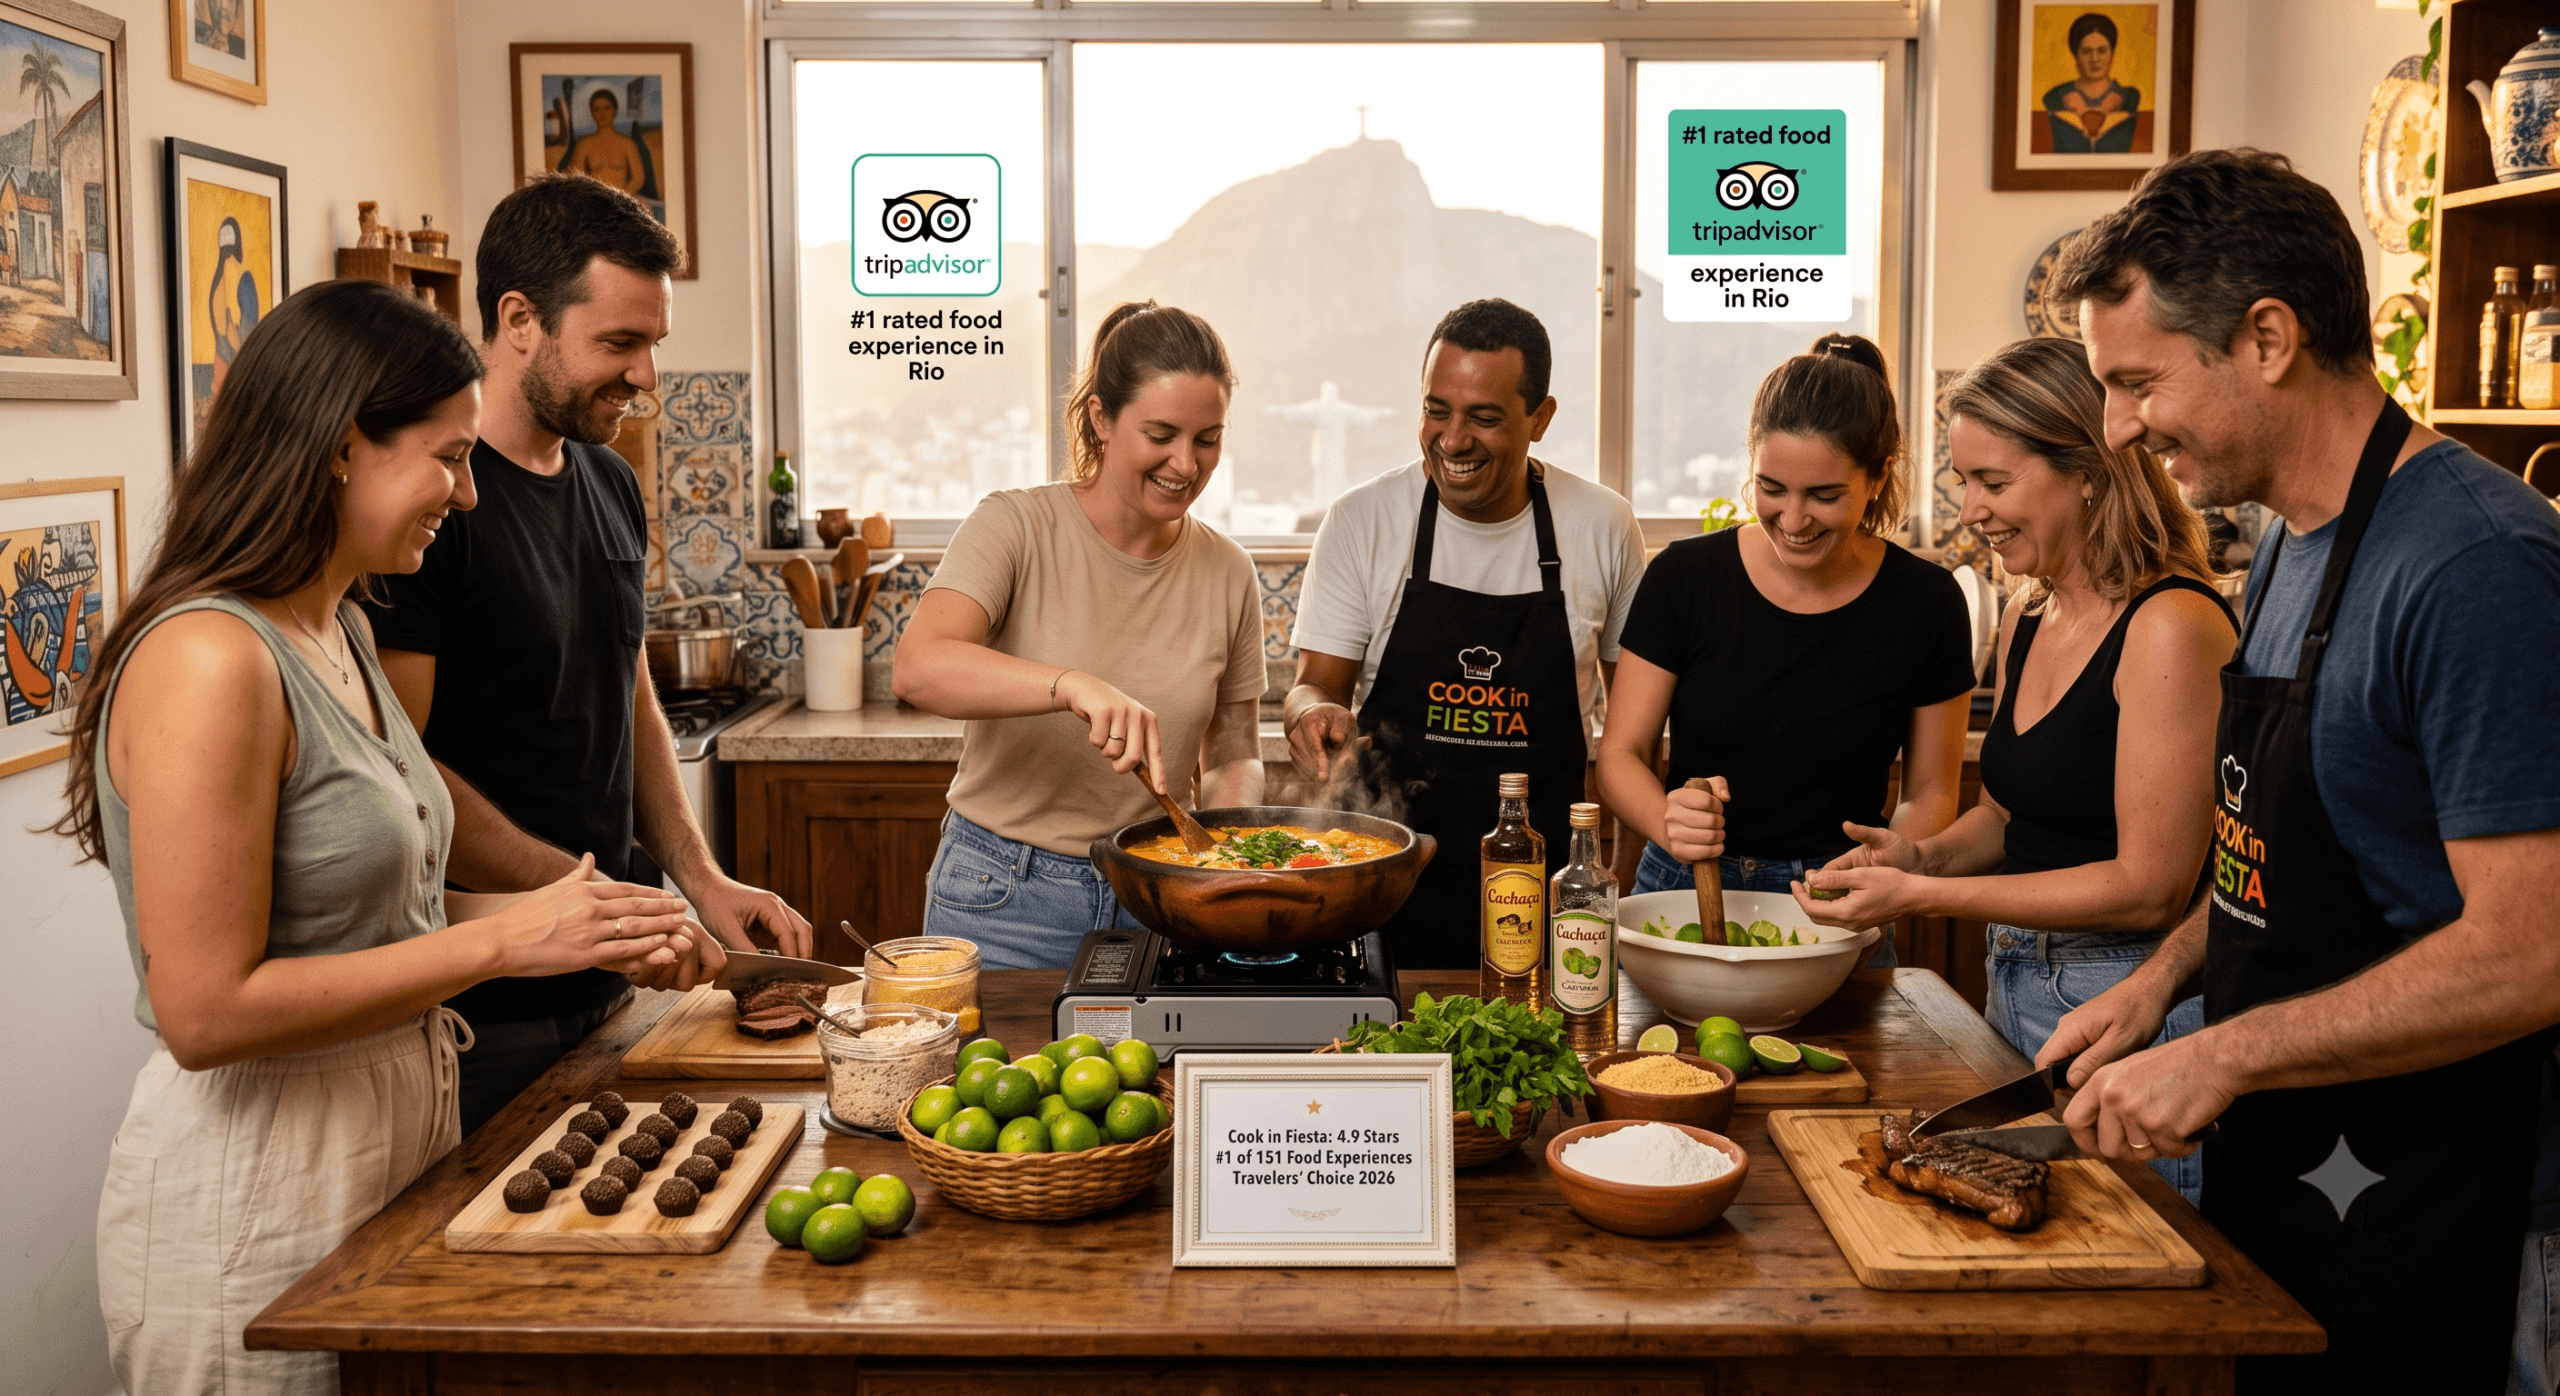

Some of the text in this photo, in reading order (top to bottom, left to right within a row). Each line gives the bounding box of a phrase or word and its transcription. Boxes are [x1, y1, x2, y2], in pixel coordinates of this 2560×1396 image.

[1428, 681, 1529, 707] COOK in
[1426, 704, 1529, 735] FIESTA
[2249, 827, 2266, 863] in
[1487, 888, 1540, 908] Cachaça
[1556, 923, 1607, 945] Cachaça
[1228, 1129, 1399, 1144] Cook in Fiesta: 4.9 Stars
[1216, 1150, 1412, 1168] #1 of 151 Food Experiences
[1307, 1170, 1355, 1185] Choice
[1359, 1170, 1396, 1185] 2026
